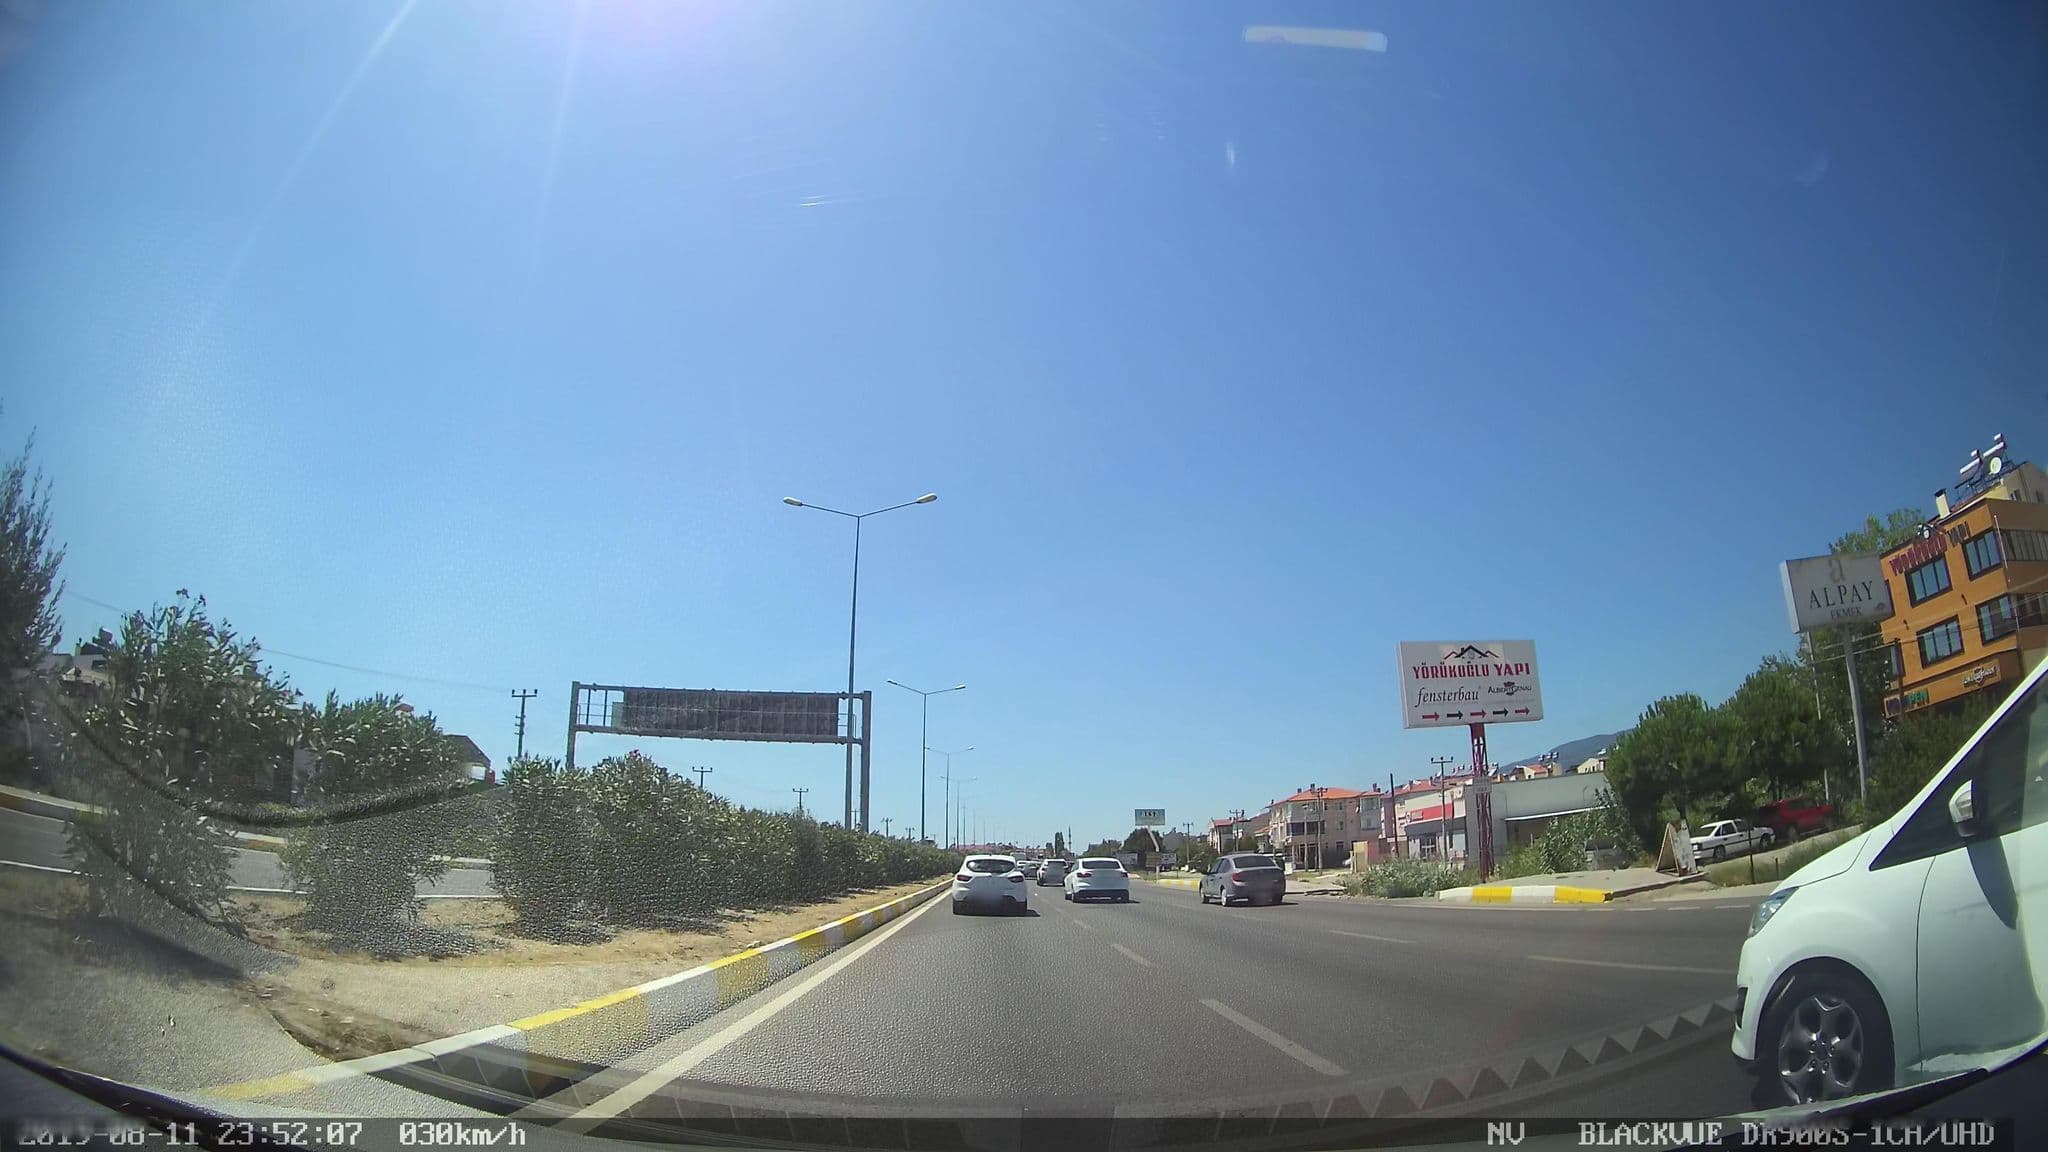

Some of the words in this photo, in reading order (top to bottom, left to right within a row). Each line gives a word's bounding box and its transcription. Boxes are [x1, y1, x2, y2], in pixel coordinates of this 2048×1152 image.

[1809, 580, 1874, 609] ALPAY
[1412, 661, 1489, 679] YÖRÜKOĞLU
[1494, 662, 1530, 675] YAPI
[1414, 686, 1479, 708] fensterbau
